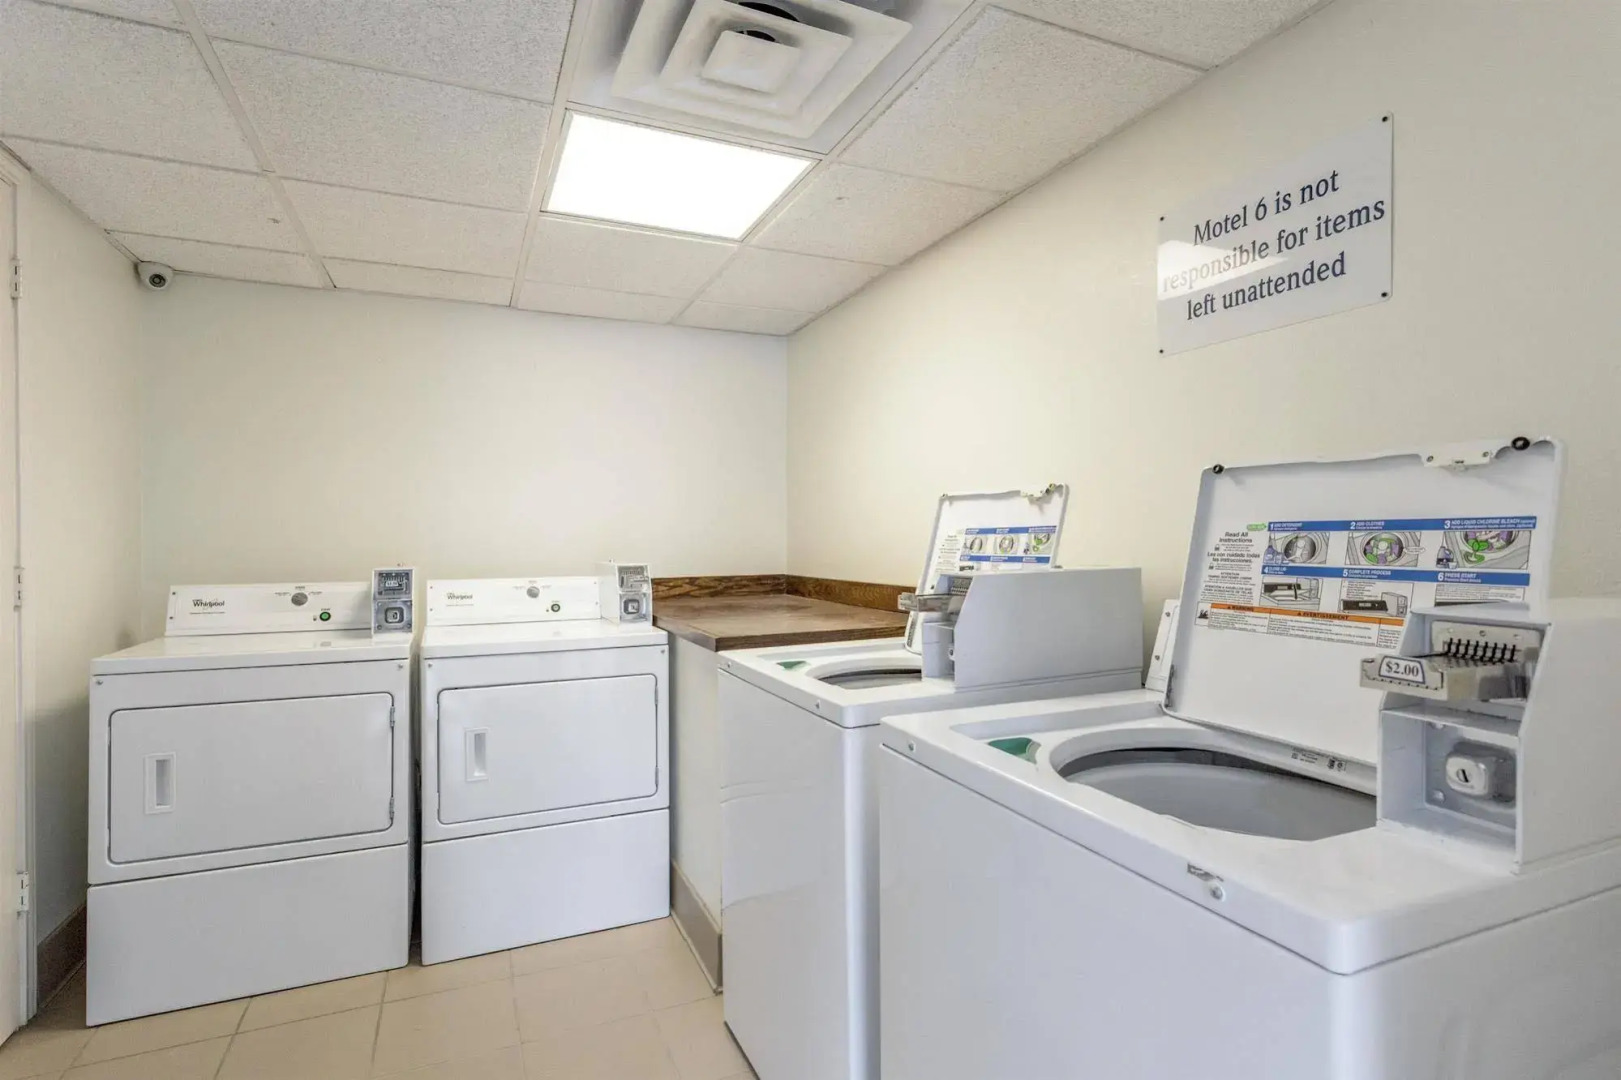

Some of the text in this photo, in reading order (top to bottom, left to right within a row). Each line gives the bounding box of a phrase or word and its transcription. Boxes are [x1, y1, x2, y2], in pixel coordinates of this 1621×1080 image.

[1193, 170, 1339, 246] Motel 6 is not
[1163, 200, 1385, 293] responsible for items
[1186, 251, 1346, 320] left unattended
[1350, 521, 1356, 530] 2
[1444, 520, 1451, 529] 3
[1343, 569, 1348, 577] 5
[1437, 572, 1444, 581] 6
[192, 599, 225, 608] Whirlpool
[1302, 611, 1350, 620] AVERTISSEMENT
[1385, 660, 1419, 677] $2.00
